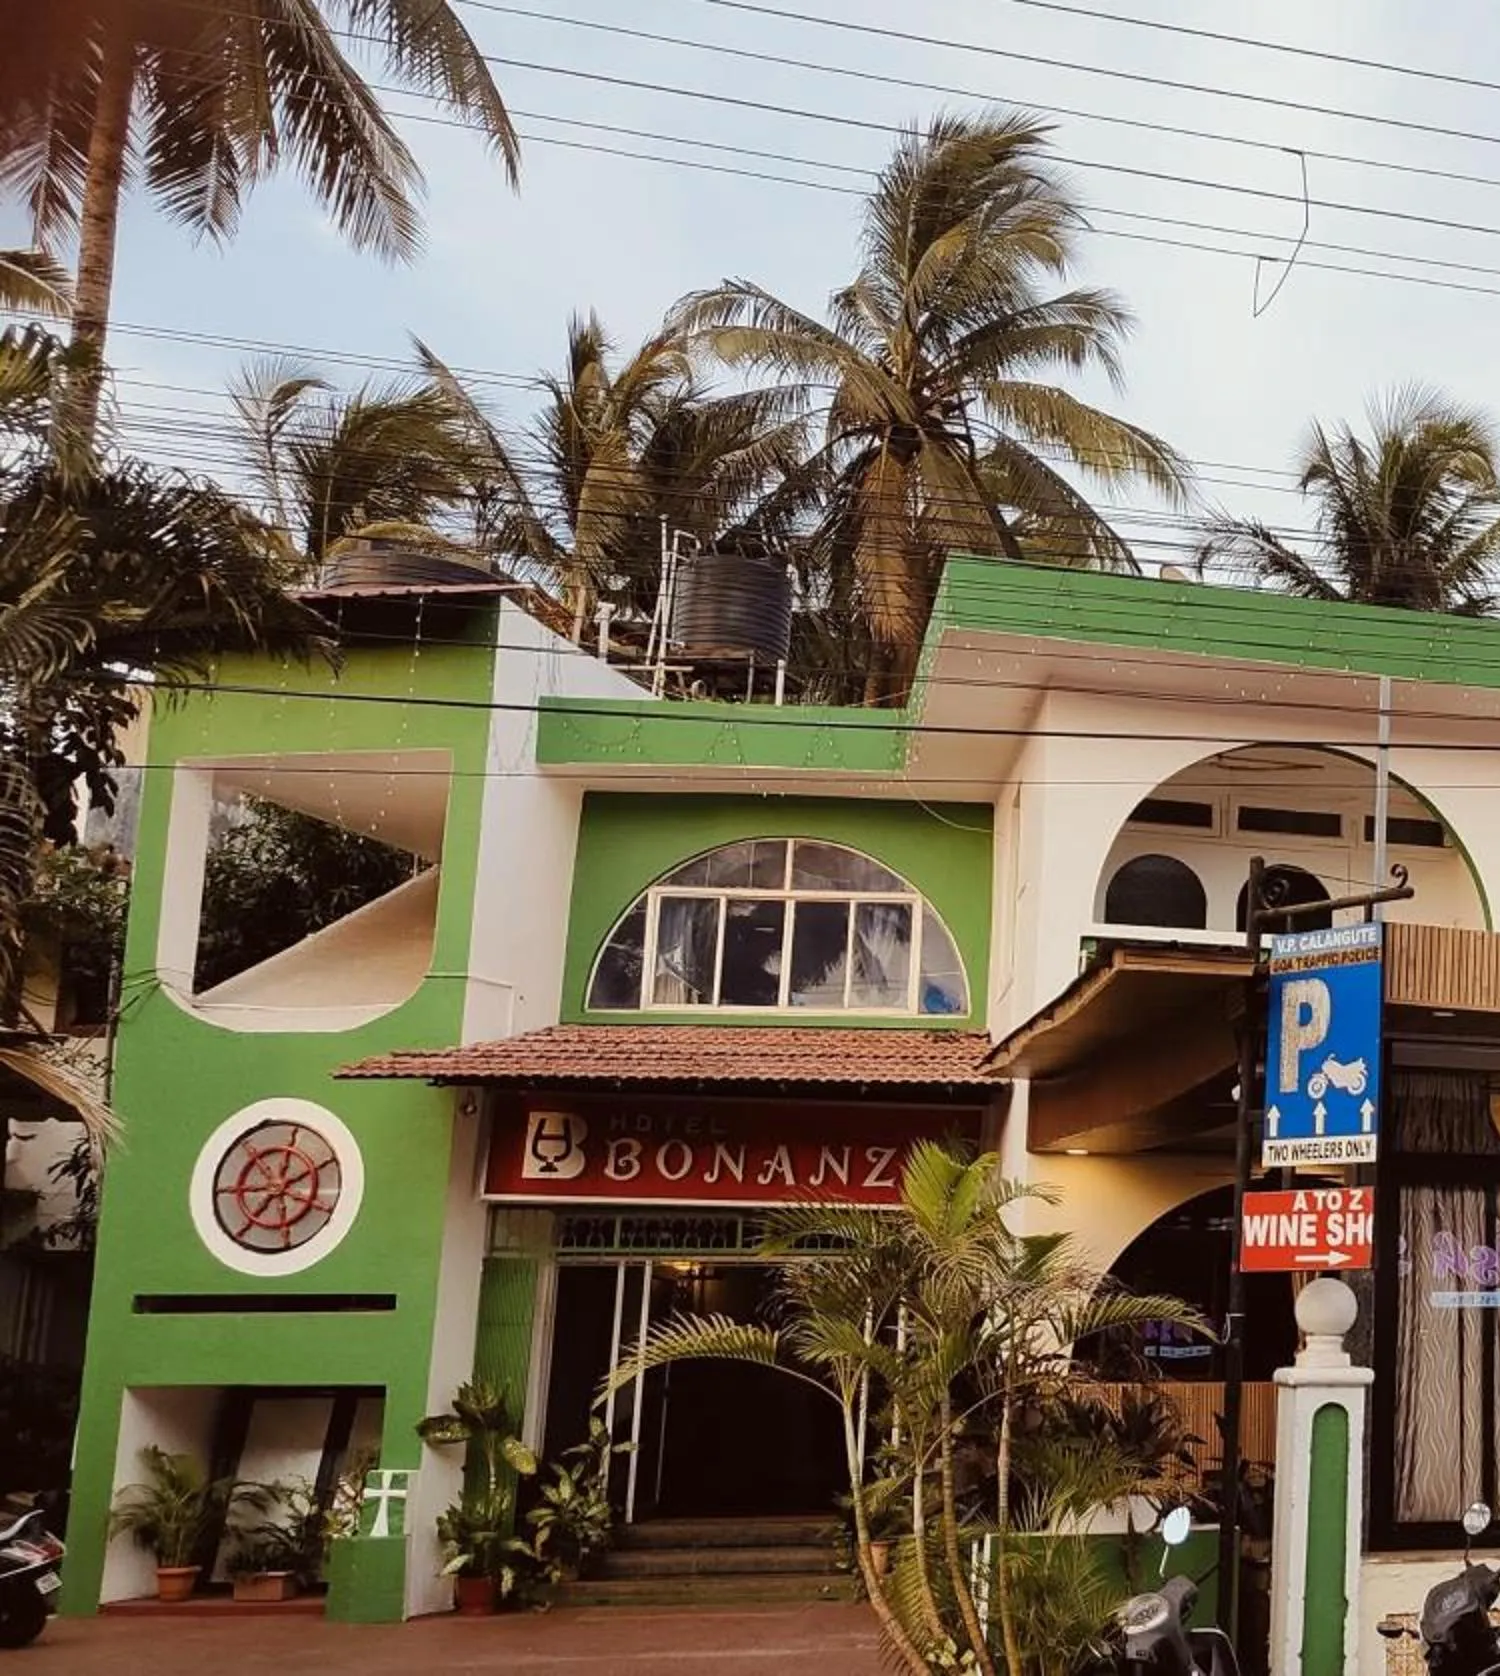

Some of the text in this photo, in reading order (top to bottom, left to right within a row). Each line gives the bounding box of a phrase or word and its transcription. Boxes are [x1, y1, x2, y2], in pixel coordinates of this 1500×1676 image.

[1299, 926, 1377, 951] CALANGUTE
[1295, 951, 1340, 970] TRAFFIC
[1341, 946, 1380, 965] POLICE
[1279, 977, 1331, 1093] P
[610, 1114, 729, 1136] HOTEL
[604, 1137, 899, 1188] BONANZ
[1268, 1139, 1371, 1162] TWO WHEELERS ONLY
[1294, 1190, 1364, 1212] A TO Z
[1244, 1213, 1317, 1248] WINE
